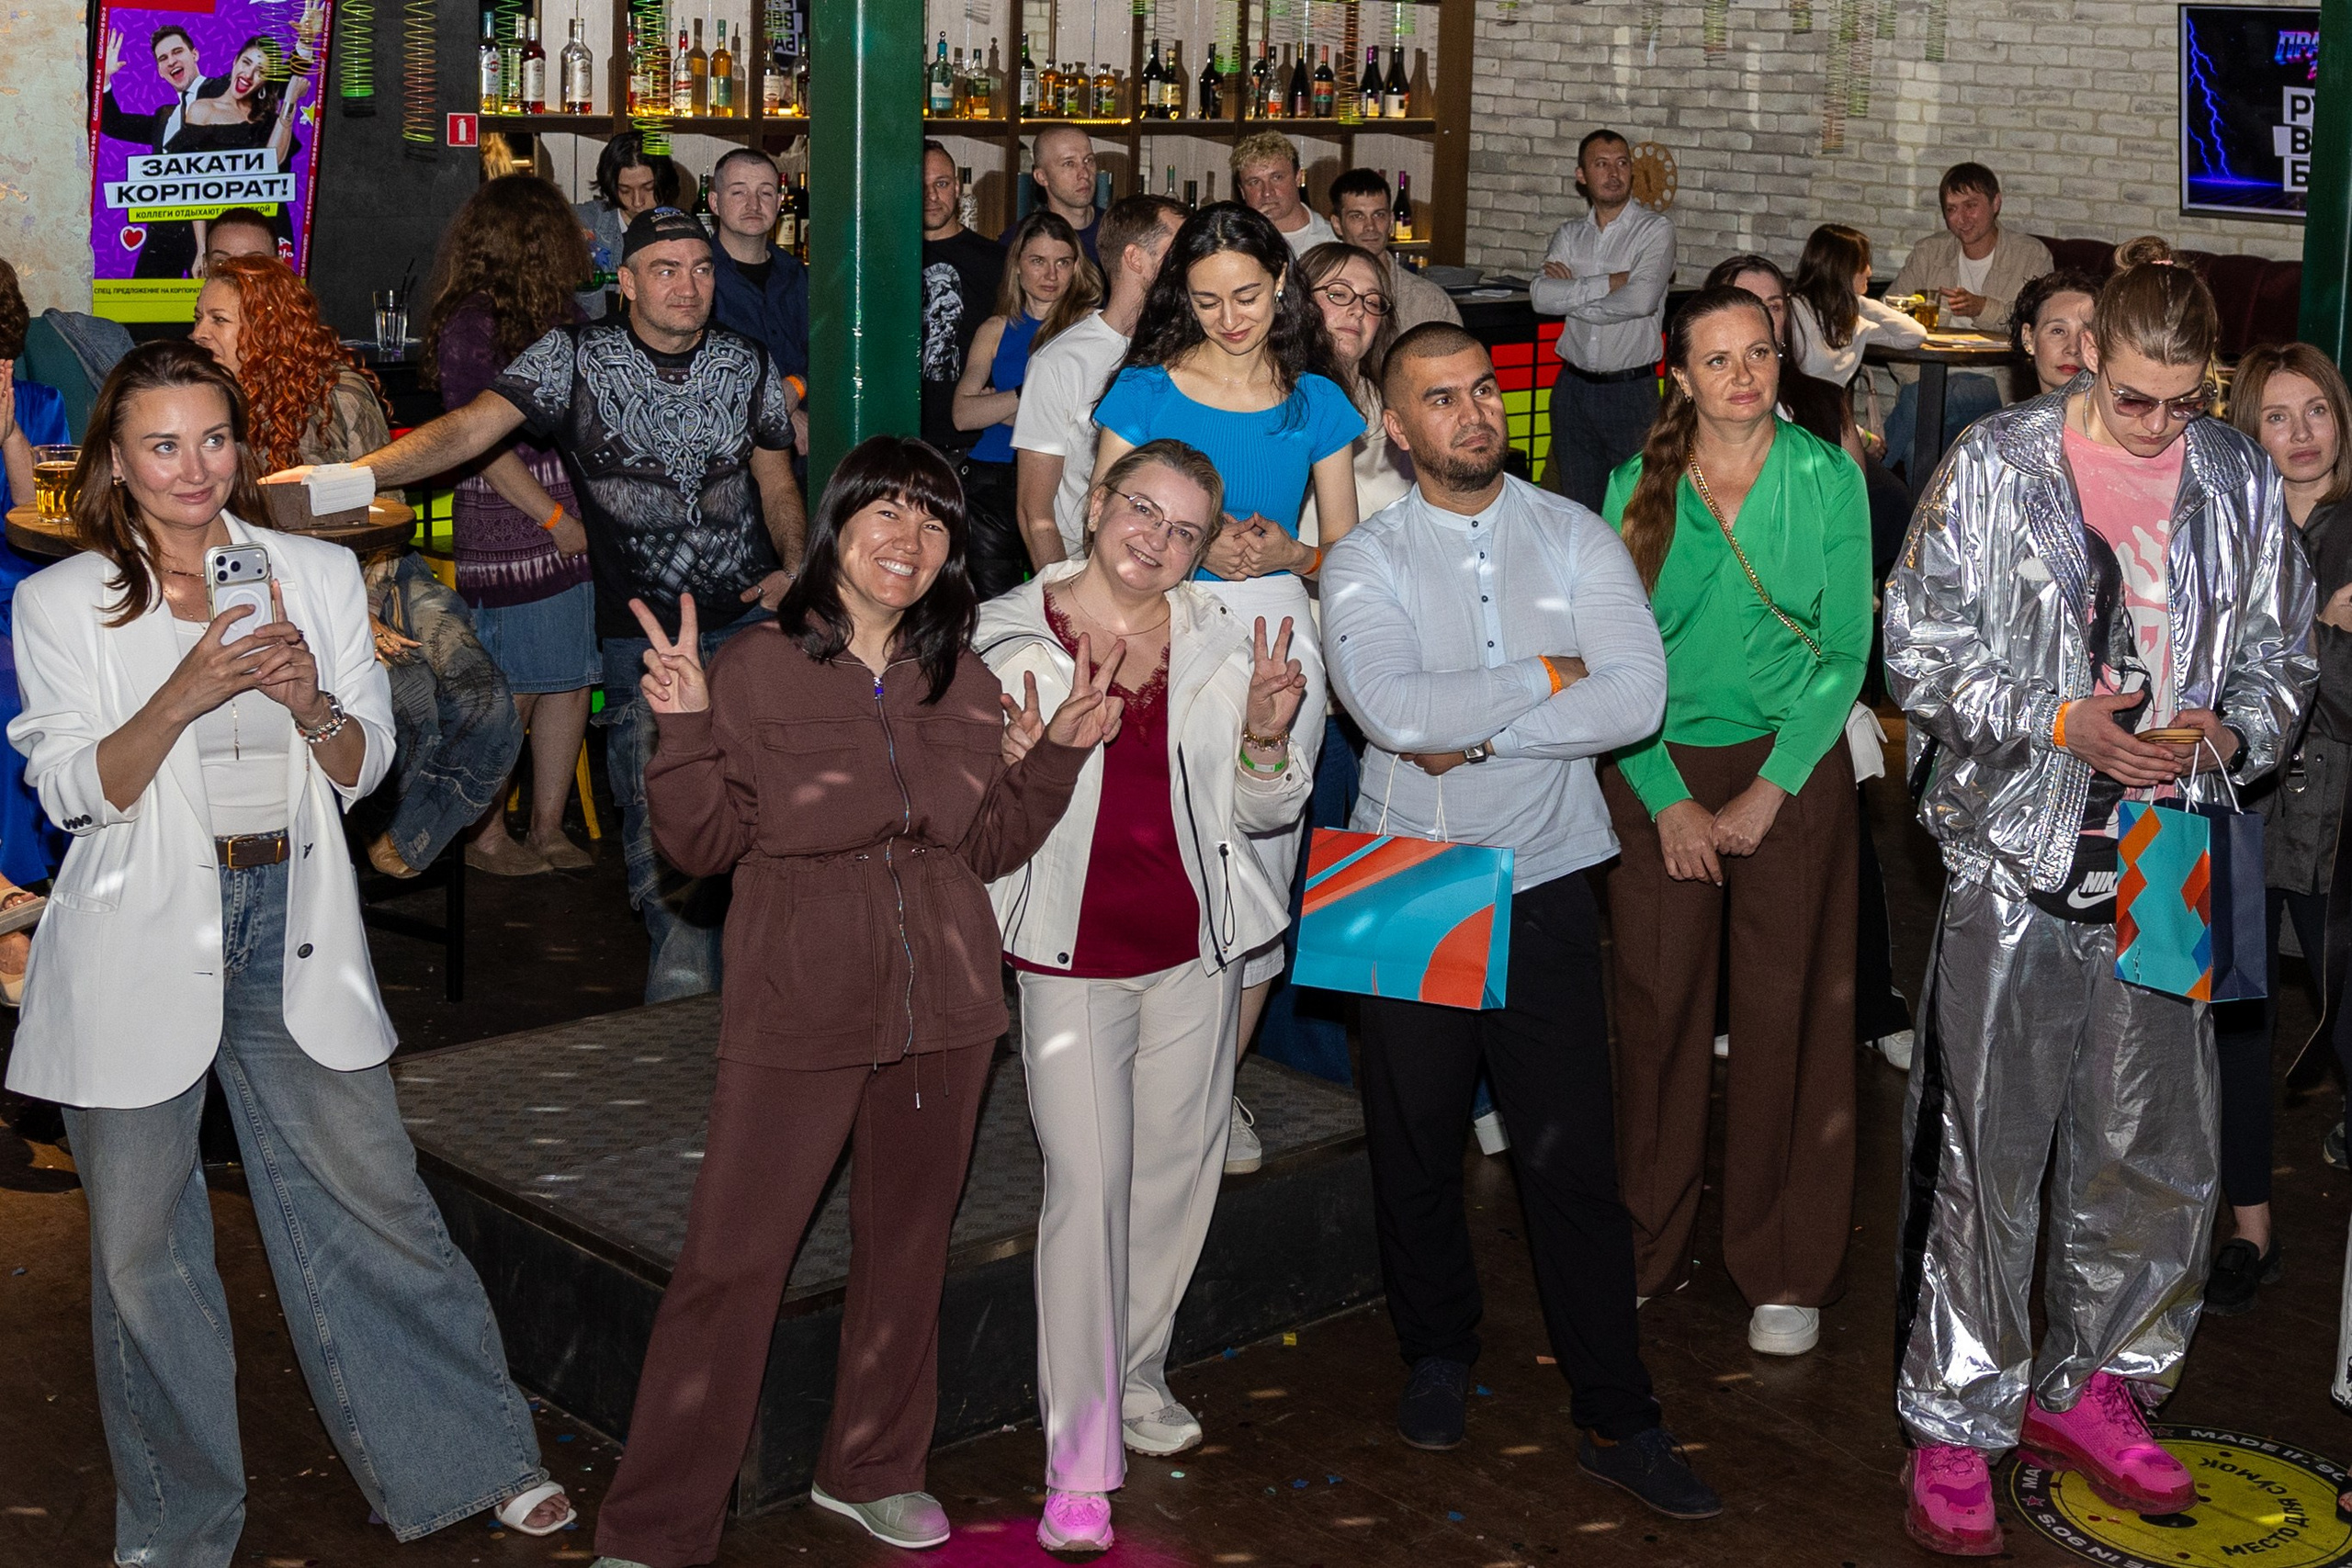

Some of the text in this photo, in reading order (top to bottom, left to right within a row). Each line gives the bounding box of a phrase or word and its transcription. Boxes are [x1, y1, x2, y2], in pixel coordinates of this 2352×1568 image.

[141, 152, 265, 177] ЗАКАТИ
[117, 178, 288, 204] КОРПОРАТ!
[135, 210, 173, 220] КОЛЛЕГИ
[175, 208, 220, 218] ОТДЫХАЮТ
[2080, 871, 2119, 894] NIK
[2190, 1429, 2280, 1453] MADE
[2022, 1464, 2042, 1489] MA
[2199, 1457, 2311, 1557] МЕСТО ДЛЯ СУМОК
[2086, 1546, 2121, 1562] IN
